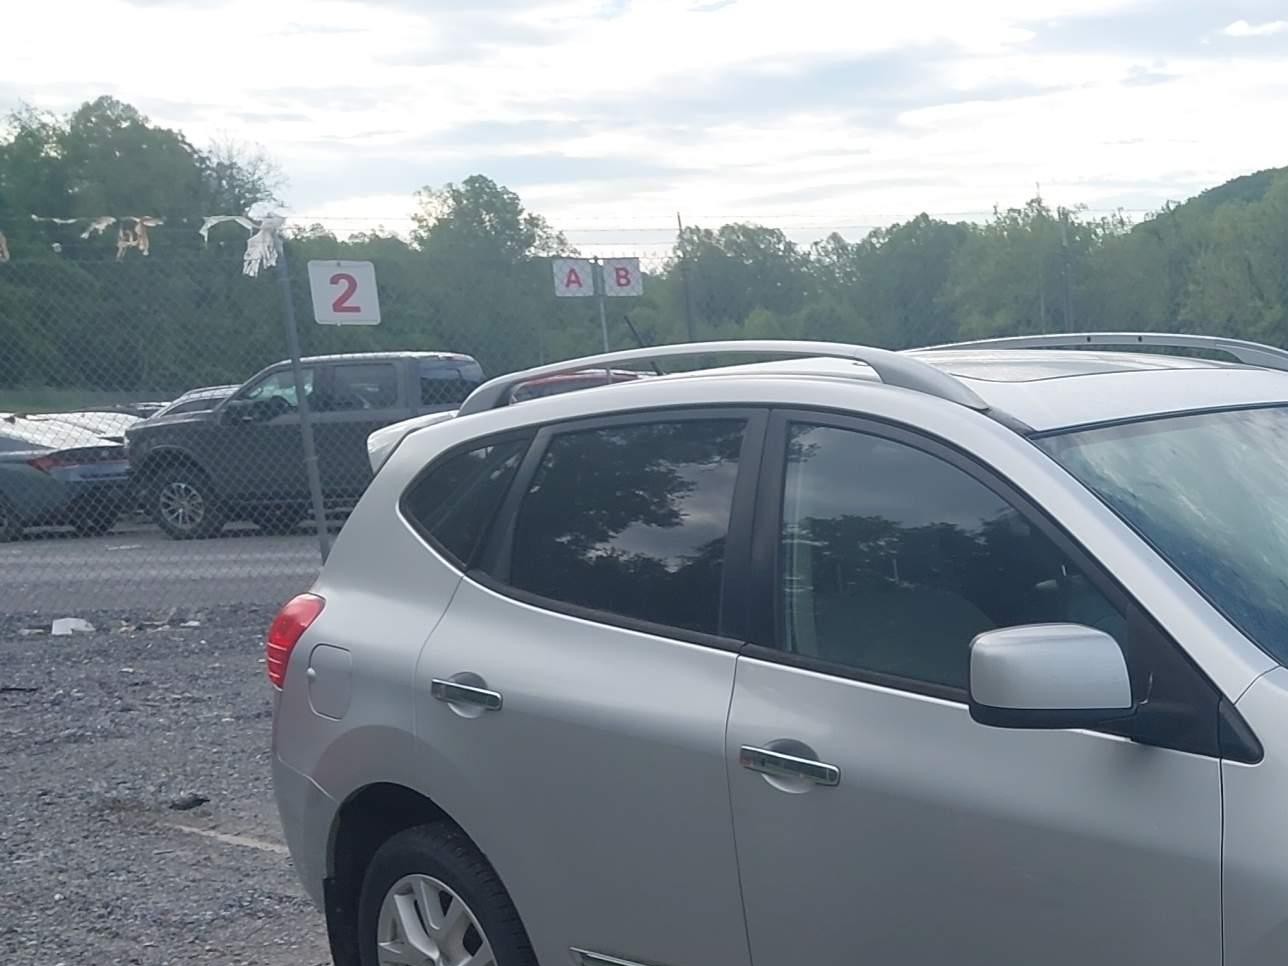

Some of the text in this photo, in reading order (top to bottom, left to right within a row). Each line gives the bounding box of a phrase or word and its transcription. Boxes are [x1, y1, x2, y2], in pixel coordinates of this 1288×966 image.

[565, 268, 582, 288] A
[615, 267, 631, 287] B
[329, 273, 362, 313] 2
